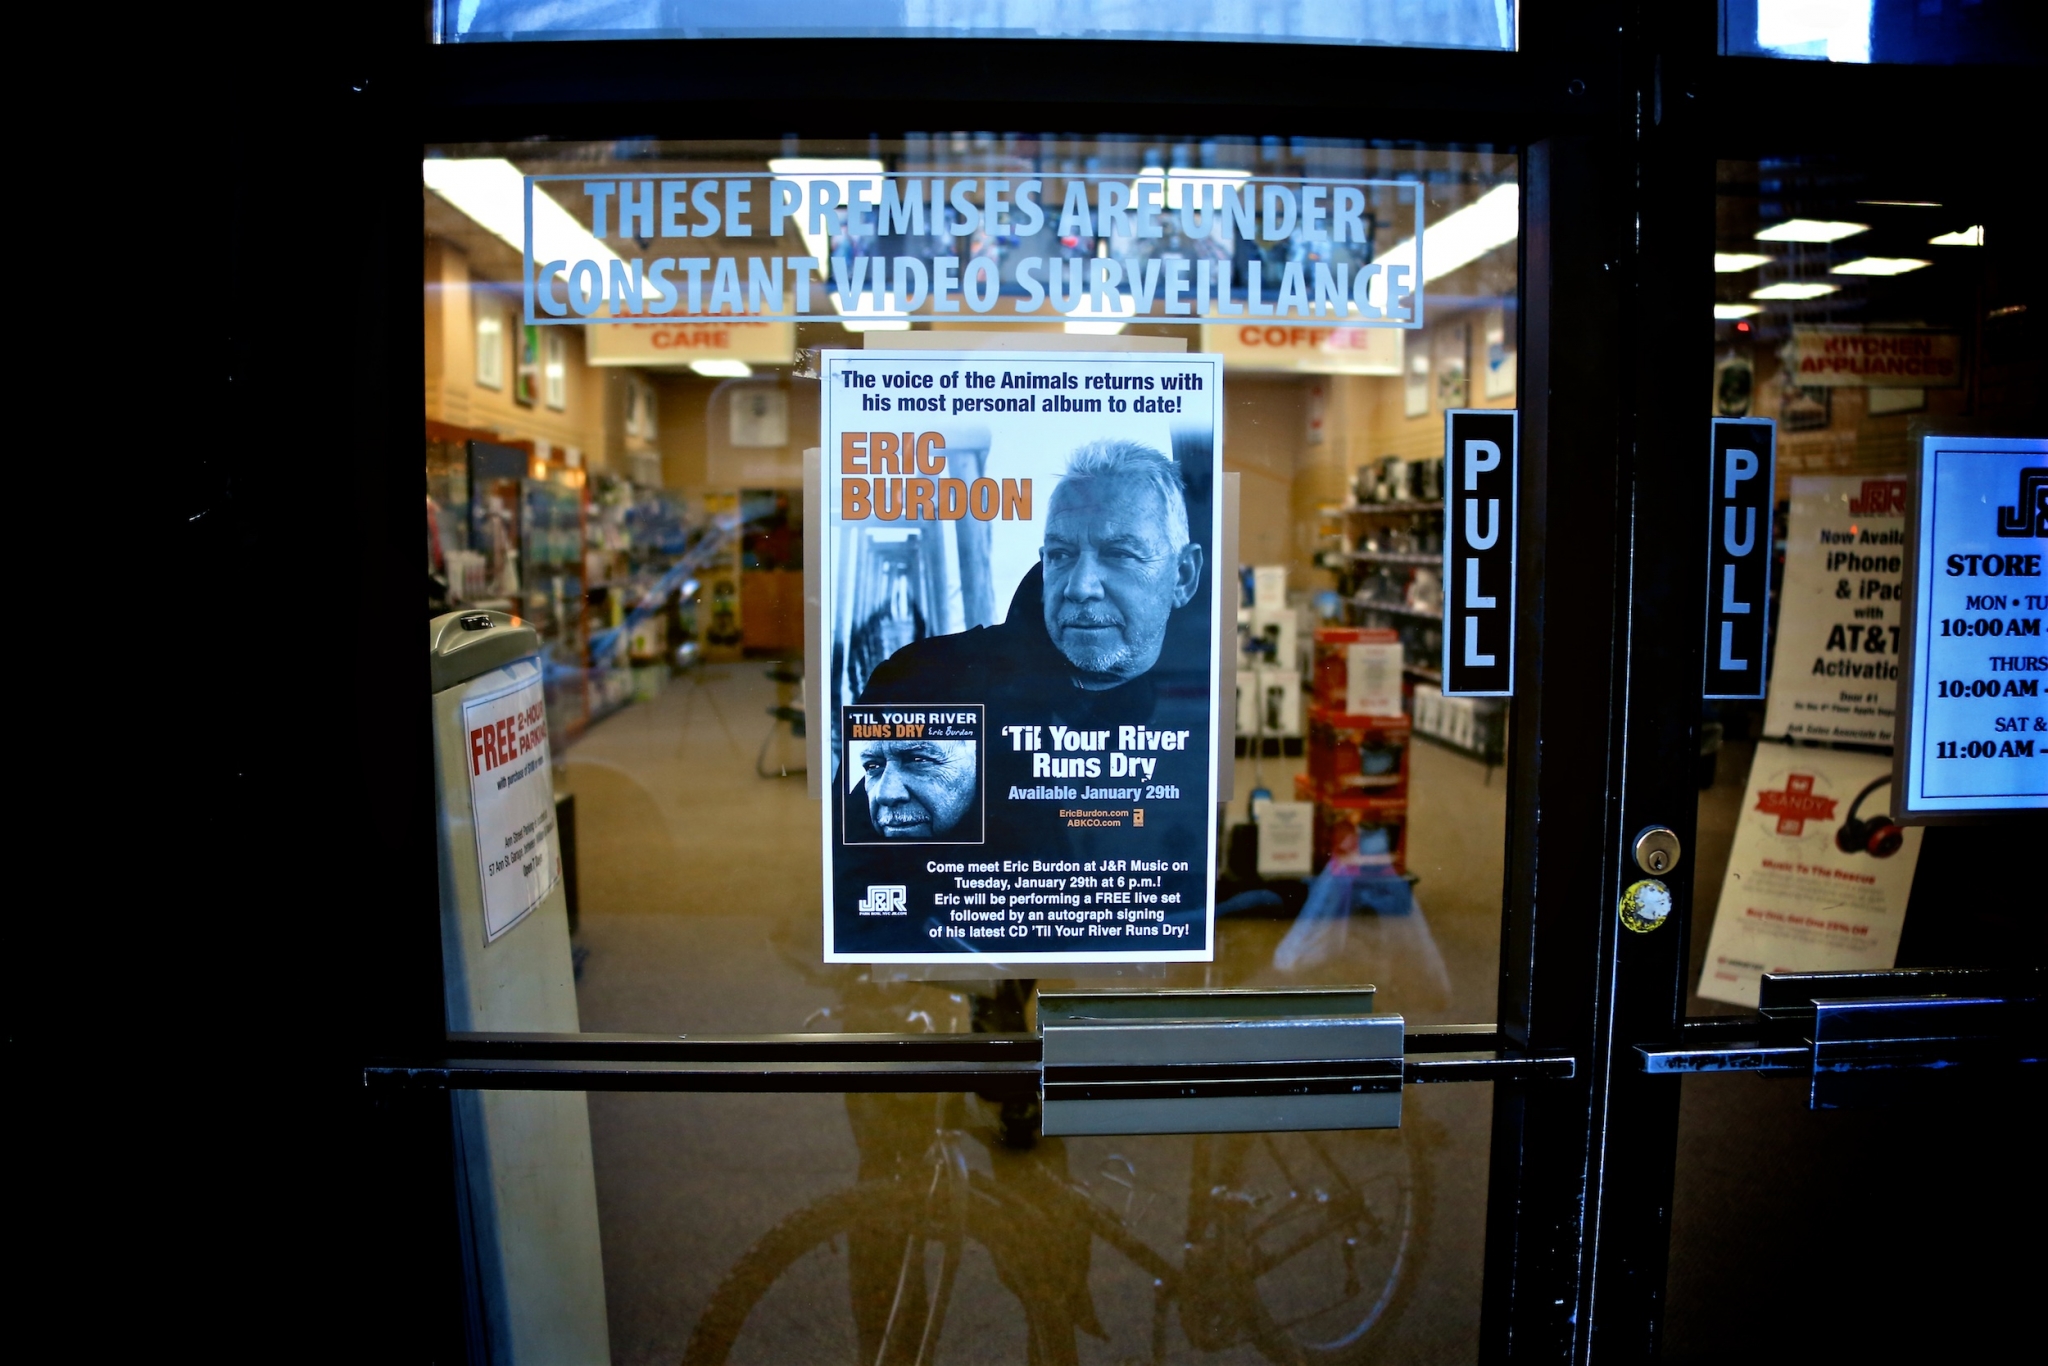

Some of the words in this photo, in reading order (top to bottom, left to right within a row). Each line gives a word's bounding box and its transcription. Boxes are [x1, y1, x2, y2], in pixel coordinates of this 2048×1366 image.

[584, 180, 752, 239] THESE
[770, 179, 1044, 238] PREMISES
[1057, 180, 1164, 239] ARE
[1181, 182, 1367, 243] UNDER
[537, 256, 819, 317] CONSTANT
[831, 256, 999, 314] VIDEO
[1014, 256, 1412, 320] SURVEILLANCE
[651, 331, 730, 349] CARE
[1239, 325, 1369, 350] COFFEE
[1824, 336, 1932, 356] KITCHEN
[1801, 355, 1955, 377] APPLIANCES
[841, 370, 876, 389] The
[882, 371, 934, 389] voice
[939, 371, 959, 389] of
[964, 371, 996, 389] the
[1000, 371, 1079, 390] Animals
[1084, 372, 1155, 391] returns
[1160, 373, 1203, 391] with
[862, 393, 892, 412] his
[897, 394, 946, 412] most
[952, 395, 1036, 416] personal
[1041, 395, 1102, 413] album
[1108, 395, 1127, 413] to
[1133, 395, 1182, 413] date!
[841, 431, 946, 475] ERIC
[841, 477, 1033, 521] BURDON
[1821, 528, 1855, 545] Now
[1464, 439, 1501, 667] PULL
[1719, 448, 1759, 670] PULL
[1946, 554, 2041, 577] STORE
[1835, 578, 1851, 599] &
[1965, 595, 2007, 611] MON
[1854, 606, 1884, 620] with
[1940, 618, 2003, 637] 10:00
[2005, 618, 2041, 637] AM
[1938, 679, 2001, 698] 10:00
[2003, 679, 2039, 698] AM
[849, 713, 878, 724] 'TIL
[882, 713, 926, 724] YOUR
[929, 713, 977, 724] RIVER
[1994, 716, 2029, 732] SAT
[2033, 716, 2047, 732] &
[852, 724, 892, 738] RUNS
[896, 724, 925, 738] DRY
[928, 726, 943, 736] Eric
[945, 725, 973, 736] Burdon
[1001, 725, 1042, 751] 'Til
[1049, 725, 1110, 751] Your
[1118, 725, 1190, 751] River
[471, 715, 518, 777] FREE
[1937, 740, 1996, 759] 11:00
[1998, 739, 2035, 758] AM
[1033, 752, 1102, 778] Runs
[1109, 752, 1157, 782] Dry
[1008, 785, 1077, 800] Available
[1080, 785, 1142, 802] January
[1145, 784, 1180, 800] 29th
[1767, 794, 1827, 810] SANDY
[1059, 809, 1129, 818] EricBurdon.com
[1067, 819, 1121, 827] ABKCO.com
[926, 861, 964, 873] Come
[968, 861, 1000, 873] meet
[1003, 860, 1029, 872] Eric
[1032, 860, 1080, 872] Burdon
[1083, 861, 1096, 872] at
[1100, 860, 1127, 872] J&R
[1130, 860, 1168, 872] Music
[1171, 862, 1189, 872] on
[954, 877, 1011, 891] Tuesday,
[1014, 877, 1066, 891] January
[1070, 876, 1097, 888] 29th
[1101, 876, 1114, 888] at
[1117, 876, 1125, 888] 6
[1128, 876, 1161, 890] p.m.!
[858, 885, 907, 911] J&R
[934, 893, 961, 905] Eric
[964, 893, 986, 905] will
[990, 893, 1006, 905] be
[1009, 892, 1080, 907] performing
[1084, 894, 1092, 904] a
[1095, 892, 1131, 904] FREE
[1134, 892, 1158, 904] live
[1161, 892, 1181, 904] set
[950, 909, 1005, 921] followed
[1008, 909, 1025, 924] by
[1028, 911, 1044, 921] an
[1047, 908, 1113, 923] autograph
[1116, 908, 1165, 922] signing
[929, 926, 942, 938] of
[945, 926, 966, 938] his
[969, 926, 1006, 938] latest
[1008, 925, 1028, 937] CD
[1031, 925, 1051, 937] 'Til
[1054, 924, 1085, 937] Your
[1088, 924, 1122, 937] River
[1125, 924, 1159, 936] Runs
[1162, 923, 1190, 938] Dry!
